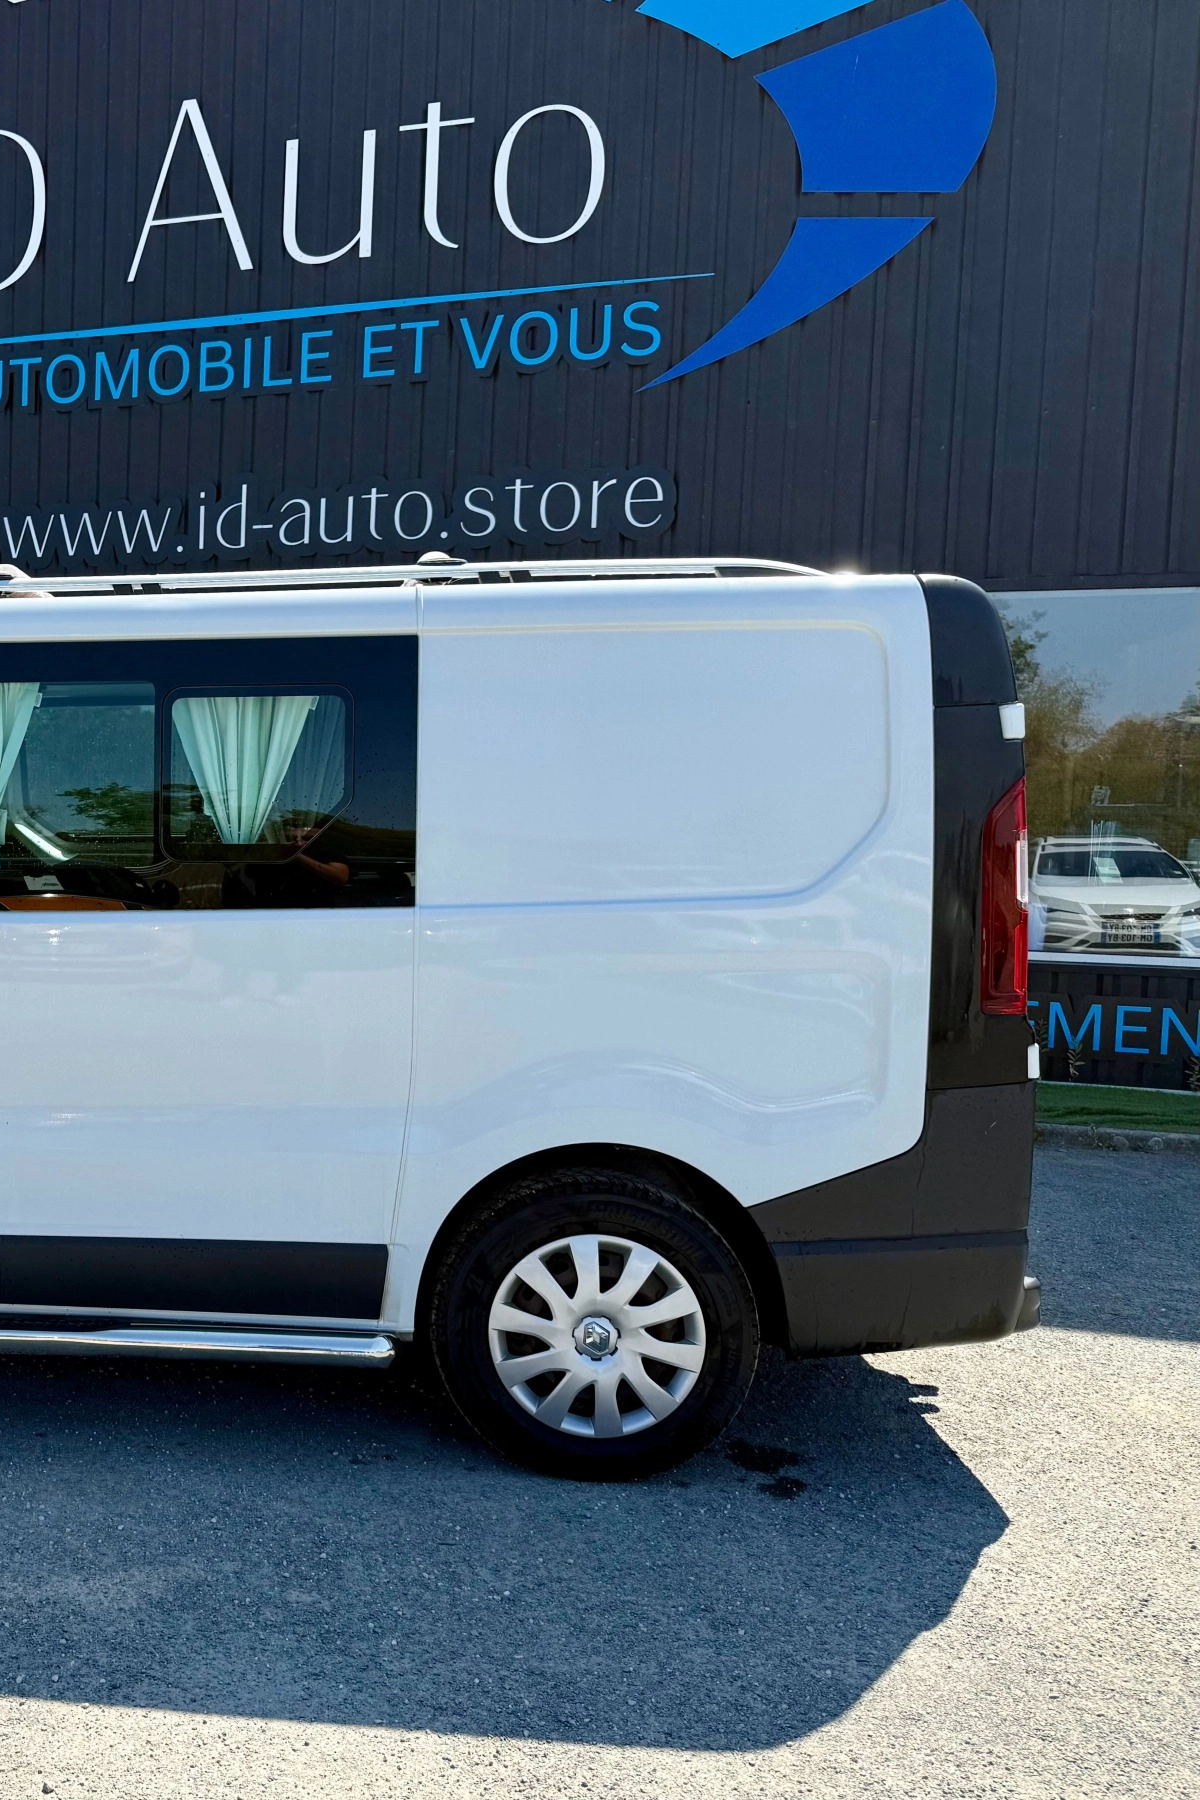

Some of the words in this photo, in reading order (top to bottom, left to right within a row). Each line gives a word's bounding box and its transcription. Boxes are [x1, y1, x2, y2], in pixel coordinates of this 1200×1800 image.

[127, 98, 606, 284] Auto
[362, 320, 440, 378] ET
[459, 300, 662, 369] VOUS
[3, 476, 664, 559] www.id-auto.store
